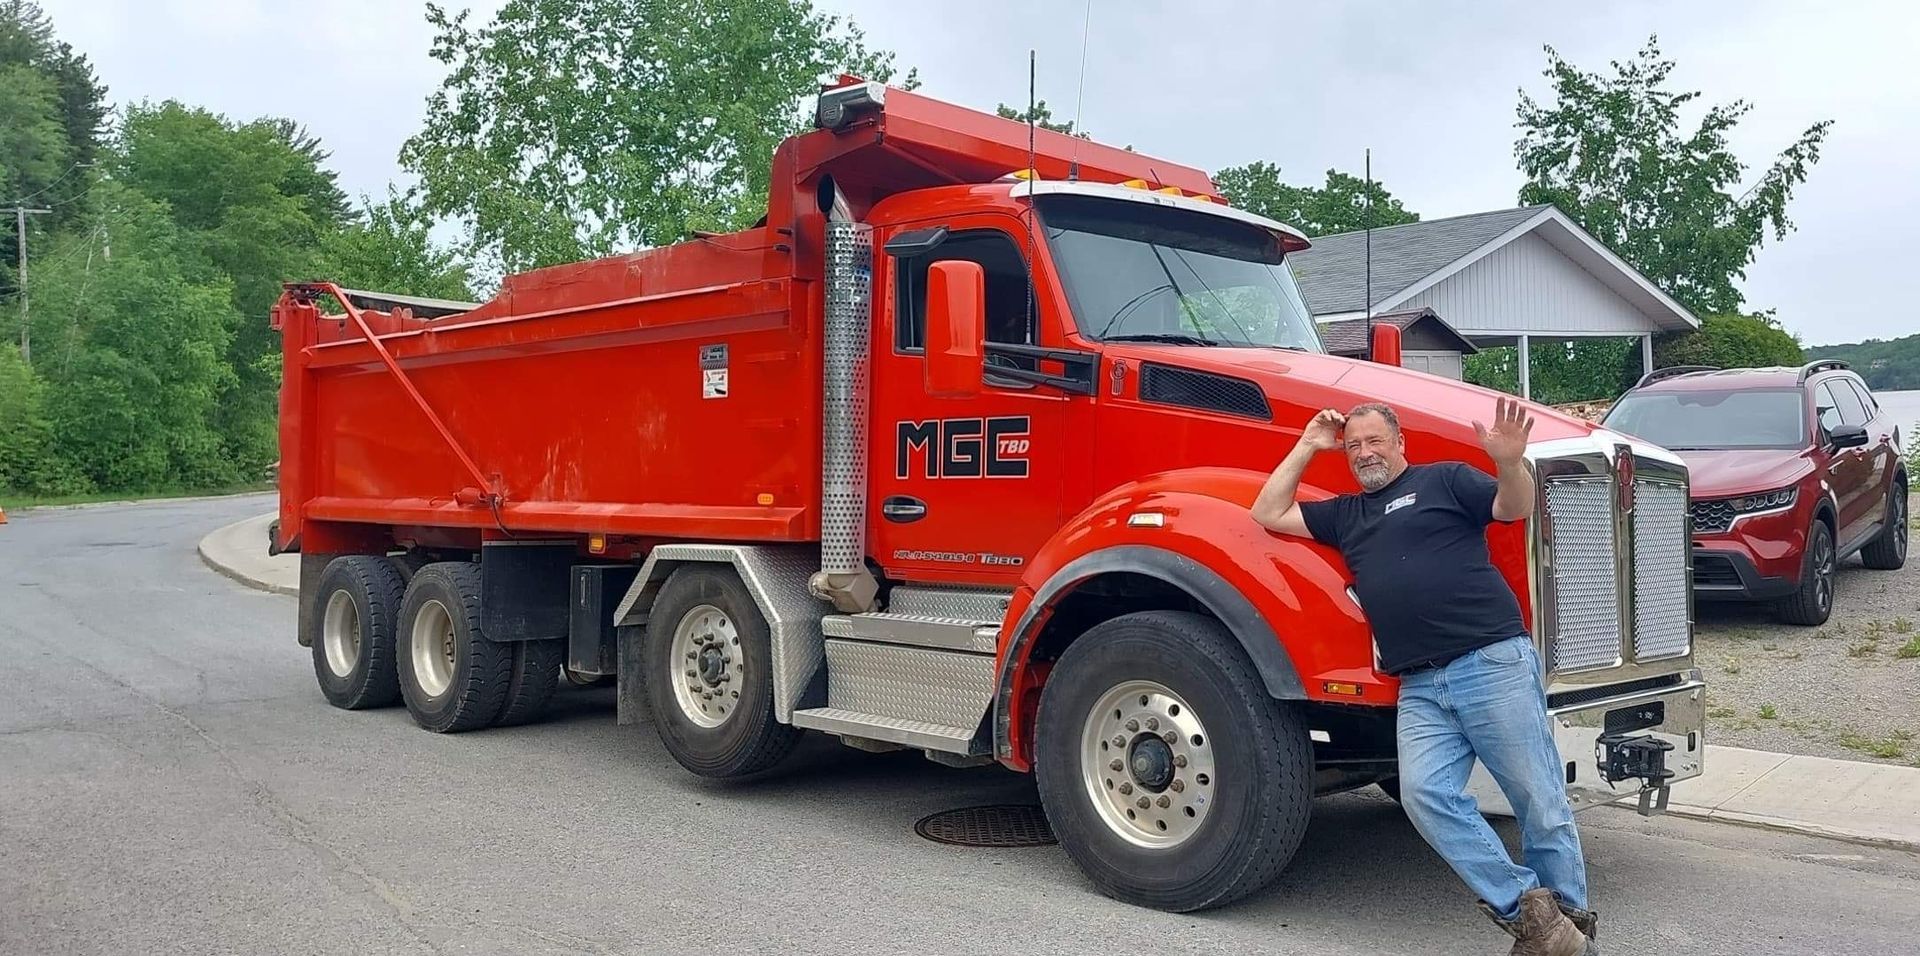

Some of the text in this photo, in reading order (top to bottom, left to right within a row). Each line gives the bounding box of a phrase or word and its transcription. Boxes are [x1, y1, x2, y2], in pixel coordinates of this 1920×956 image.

[896, 415, 1030, 479] MGC
[999, 440, 1029, 454] TBD
[977, 552, 1023, 566] T880
